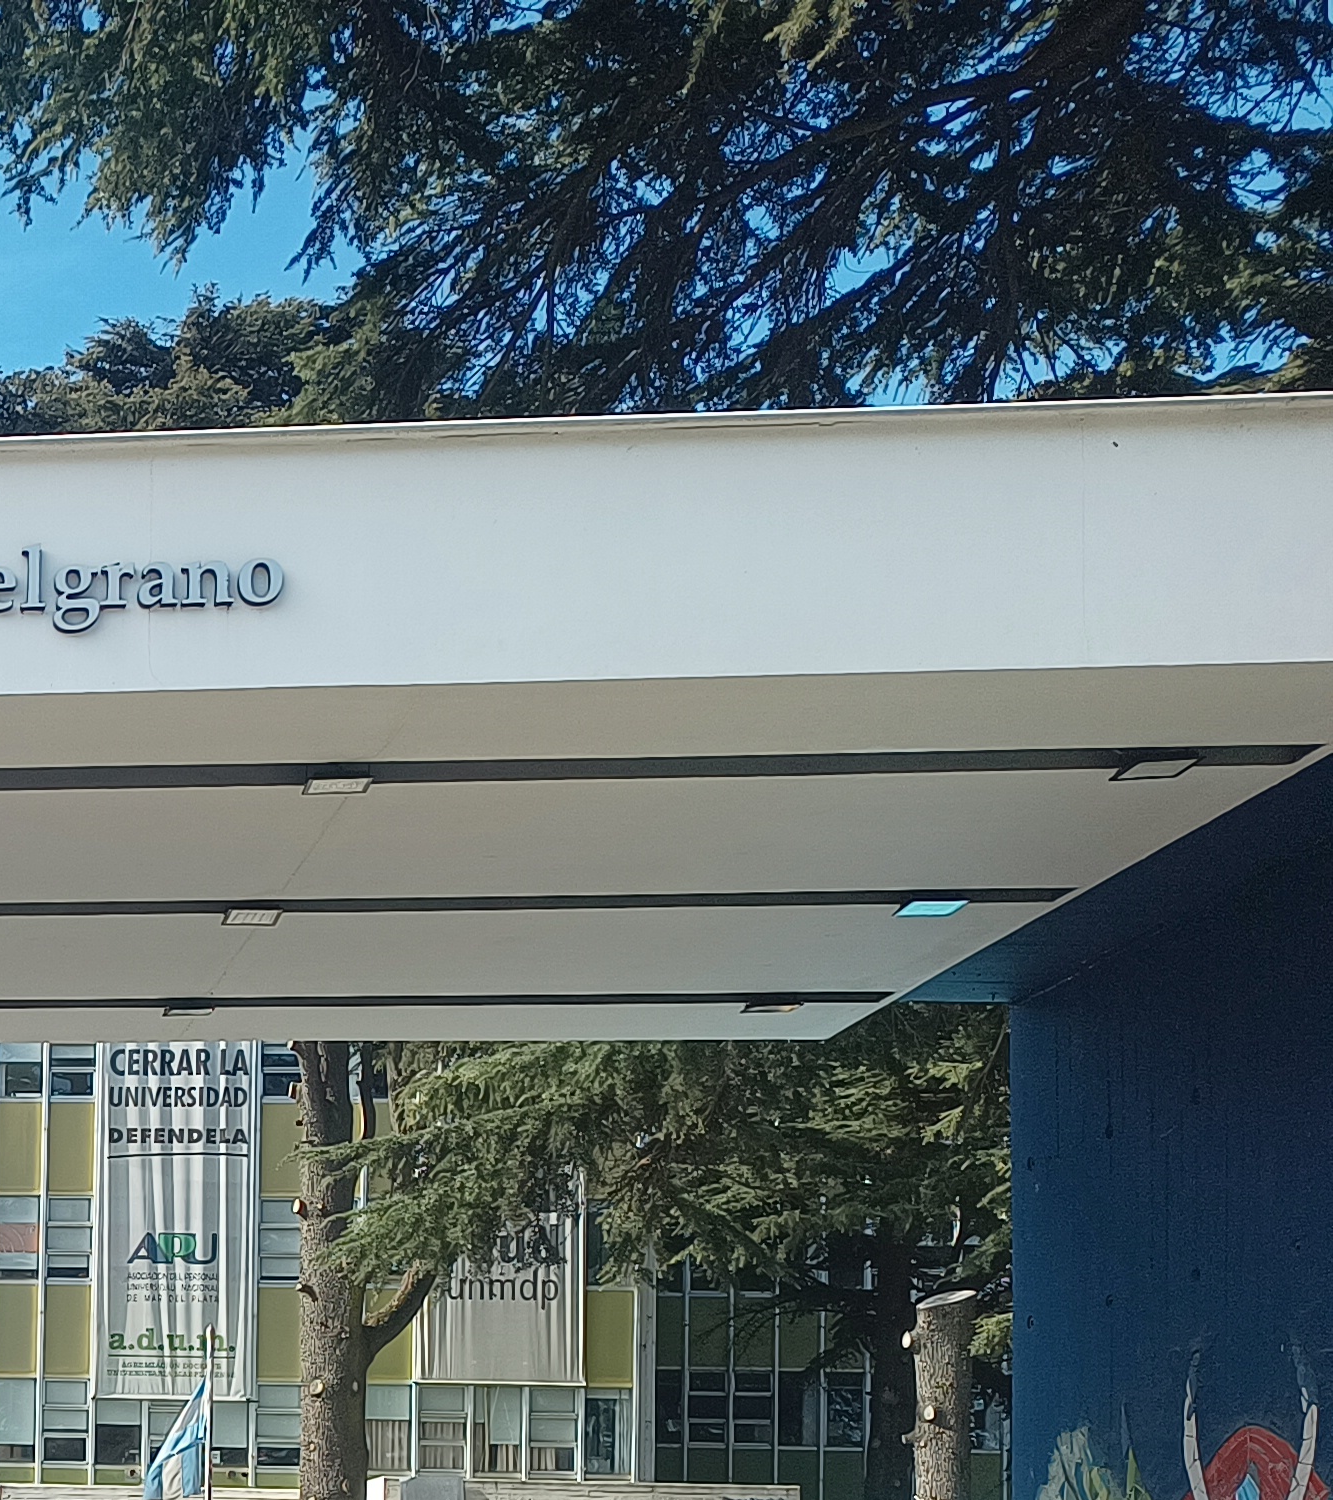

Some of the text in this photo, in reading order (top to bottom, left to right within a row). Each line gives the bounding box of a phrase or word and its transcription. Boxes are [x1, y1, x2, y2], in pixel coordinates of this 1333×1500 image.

[109, 1048, 249, 1076] CERRAR LA
[109, 1086, 248, 1107] UNIVERSIDAD
[109, 1127, 248, 1144] DEFENDELA
[447, 1267, 559, 1310] unmdp
